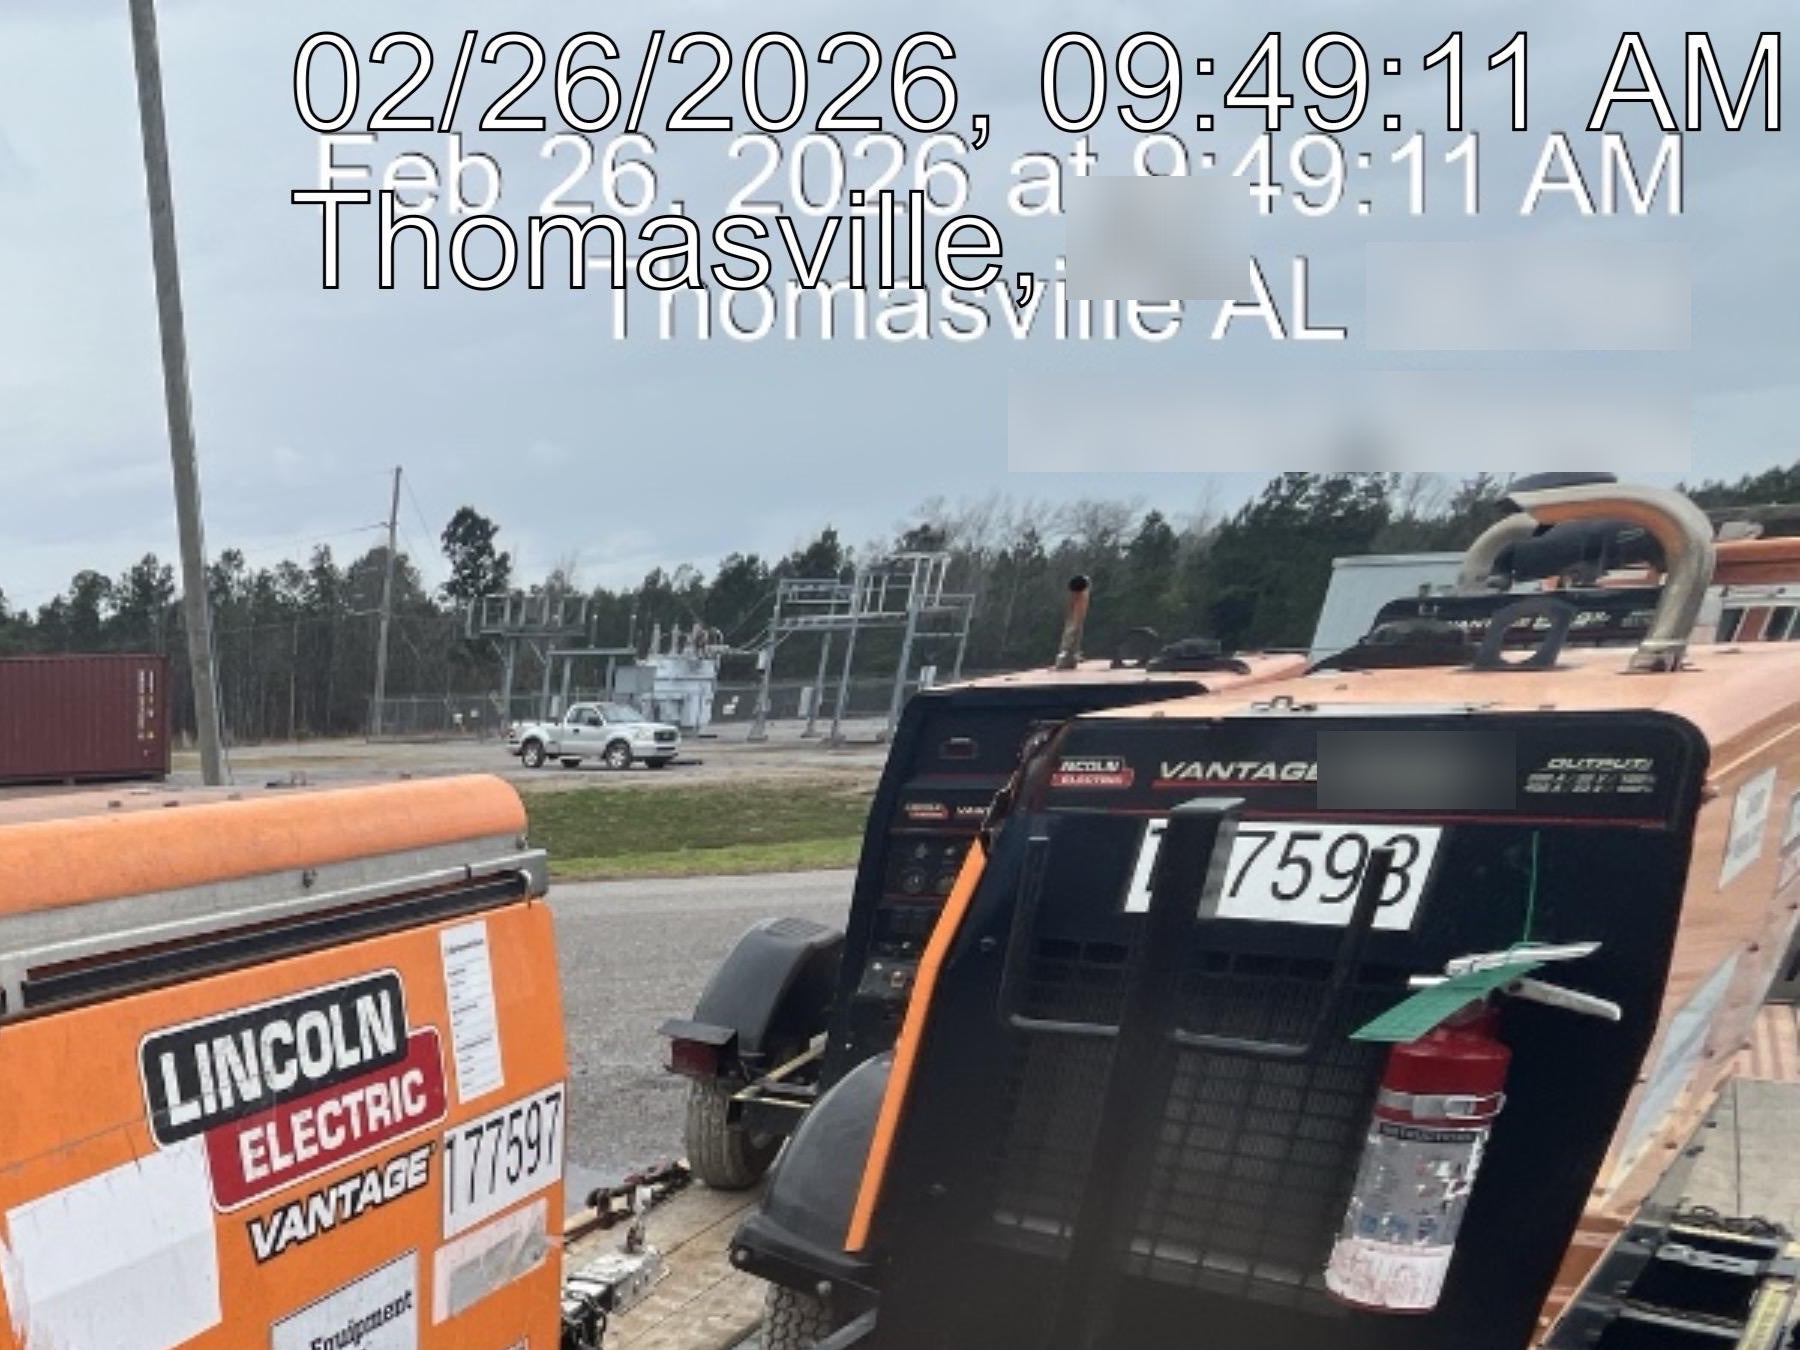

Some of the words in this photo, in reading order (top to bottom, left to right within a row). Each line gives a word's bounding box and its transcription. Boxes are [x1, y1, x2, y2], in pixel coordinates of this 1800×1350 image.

[159, 989, 398, 1127] LINCOLN
[238, 1068, 427, 1184] ELECTRIC
[445, 1091, 562, 1217] 177597
[247, 1147, 432, 1262] VANTAGE
